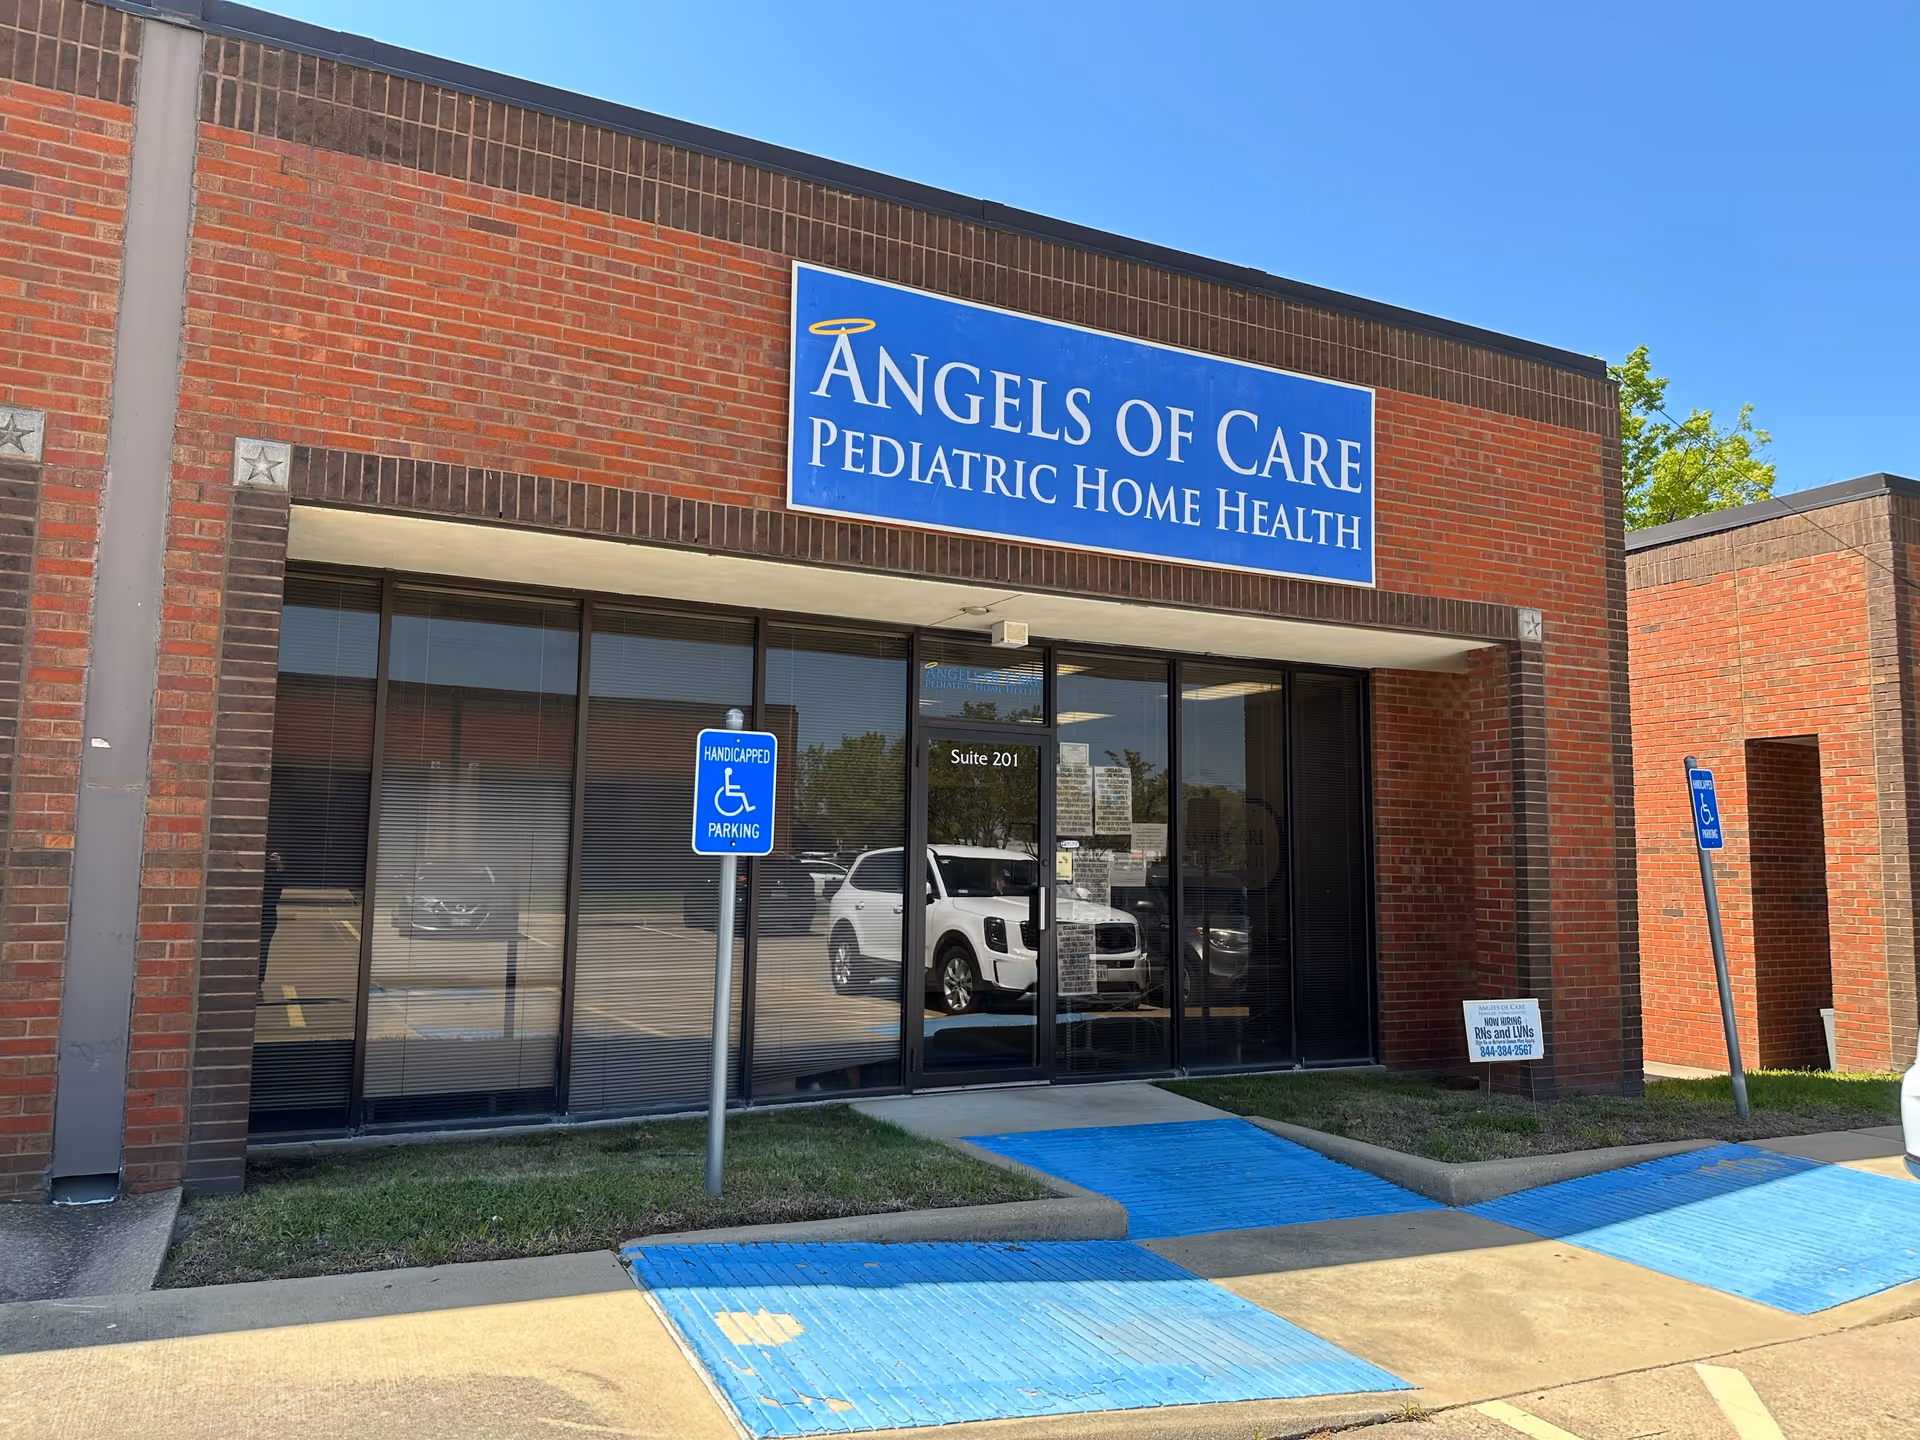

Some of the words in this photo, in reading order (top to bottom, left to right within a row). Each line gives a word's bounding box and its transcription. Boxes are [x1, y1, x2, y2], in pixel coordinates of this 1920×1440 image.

[809, 327, 1092, 446] ANGELS
[1115, 398, 1194, 464] OF
[1216, 409, 1363, 495] CARE
[808, 416, 1058, 505] PEDIATRIC
[1073, 464, 1202, 528] HOME
[1215, 487, 1362, 551] HEALTH
[925, 678, 973, 691] PEDIATRIC
[975, 682, 1003, 694] HOME
[1006, 684, 1041, 697] HEALTH
[704, 745, 771, 764] HANDICAPPED
[950, 748, 988, 766] Suite
[992, 751, 1018, 767] 201
[708, 822, 760, 839] PARKING
[1701, 828, 1719, 839] PARKING
[1478, 1004, 1500, 1012] ANGELS
[1484, 1017, 1499, 1027] NOW
[1500, 1016, 1522, 1026] HIRING
[1474, 1026, 1492, 1040] RNs
[1494, 1026, 1511, 1039] and
[1513, 1025, 1535, 1038] LVNs
[1480, 1044, 1533, 1058] 844-384-2567
